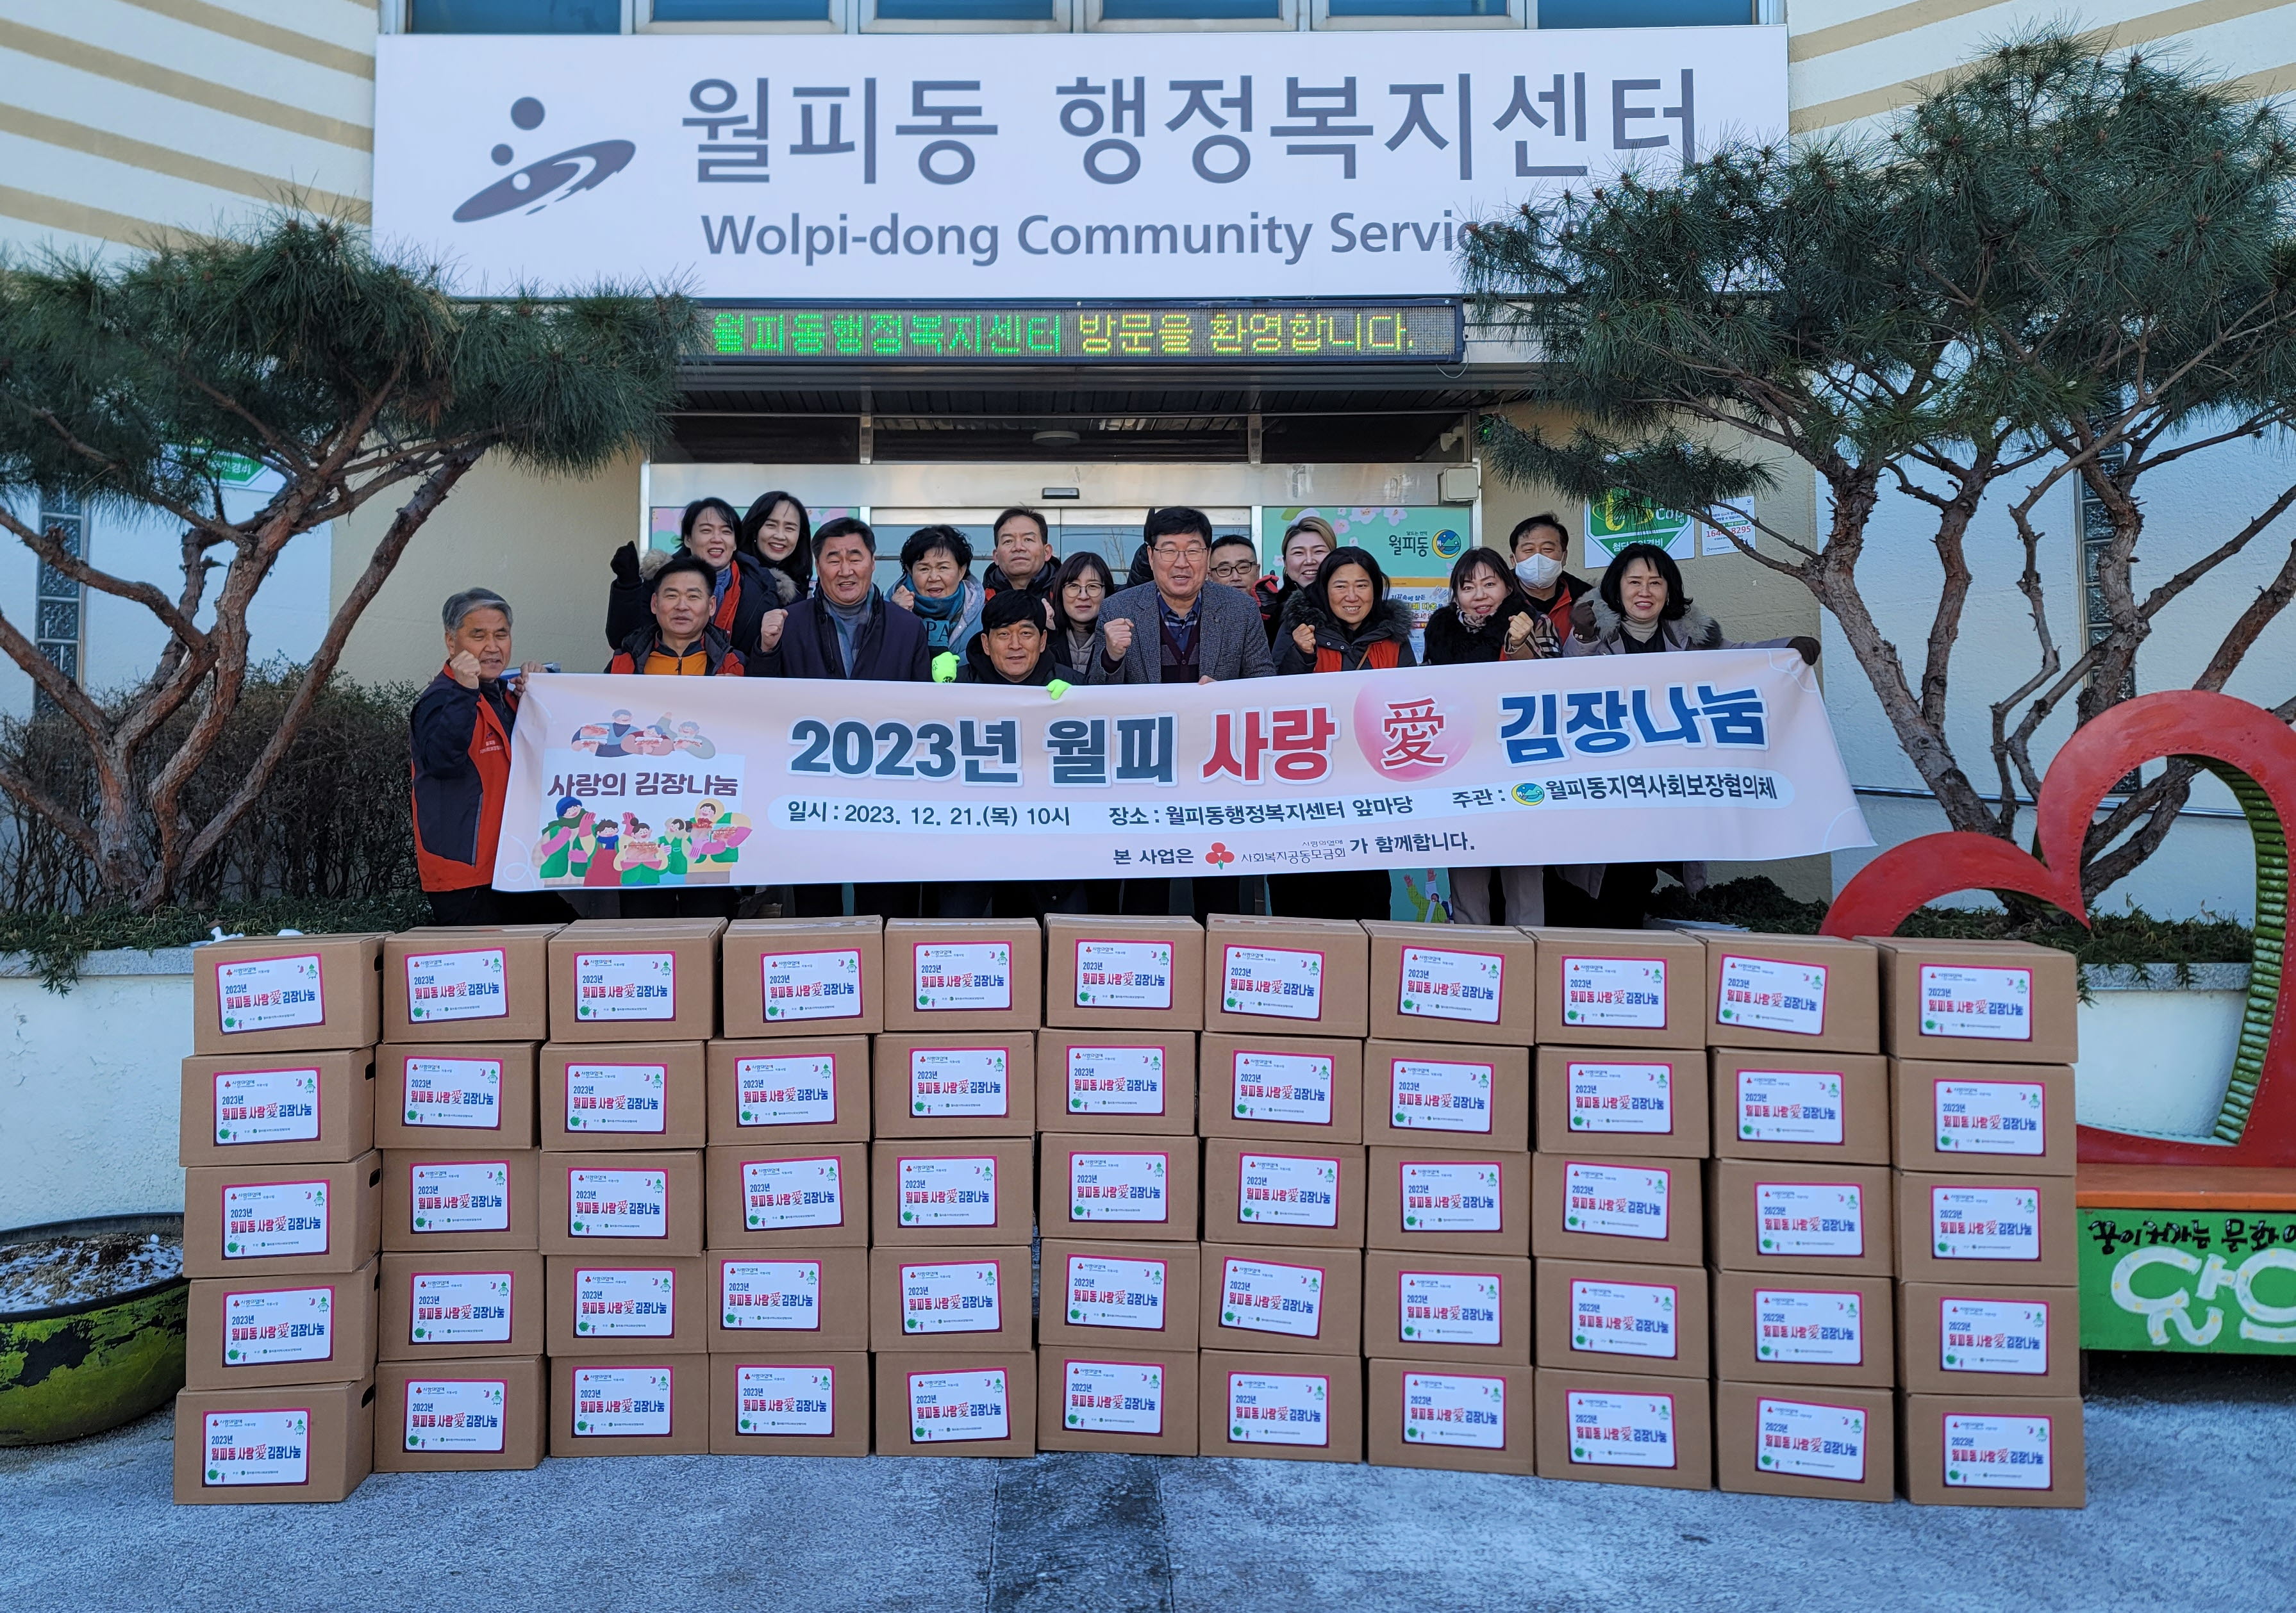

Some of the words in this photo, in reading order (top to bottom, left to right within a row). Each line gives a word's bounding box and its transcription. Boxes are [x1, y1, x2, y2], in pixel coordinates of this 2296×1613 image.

[682, 77, 999, 185] 월피동
[1056, 69, 1694, 185] 행정복지센터
[701, 212, 999, 267] Wolpi-dong
[1017, 211, 1313, 266] Community
[1329, 209, 1506, 255] Servic
[711, 313, 1061, 353] 월피동행정복지센터
[1079, 313, 1193, 353] 방문을
[1210, 312, 1415, 352] 환영합니다.
[1388, 535, 1429, 558] 월피동
[790, 719, 1019, 783] 2023년
[1047, 716, 1174, 784] 월피
[1202, 707, 1336, 781] 사랑
[1383, 697, 1447, 768] 愛
[1501, 684, 1767, 765] 김장나눔
[547, 772, 626, 798] 사랑의
[634, 772, 738, 797] 김장나눔
[1545, 773, 1777, 801] 월피동지역사회보장협의체
[1026, 806, 1070, 827] 10시
[1165, 800, 1345, 826] 월피동행정복지센터
[1351, 795, 1413, 818] 앞마당
[1113, 849, 1133, 866] 본
[1138, 847, 1194, 865] 사업은
[1241, 847, 1345, 864] 사회복지공동모금회
[1349, 837, 1368, 854] 가
[1375, 831, 1476, 852] 함께합니다.
[1231, 966, 1252, 977] 2023년
[582, 974, 603, 983] 2023년
[1570, 979, 1592, 988] 2023년
[225, 983, 247, 994] 2023년
[582, 986, 606, 998] 월피동
[636, 985, 668, 997] 김장나눔
[1229, 977, 1254, 992] 월피동
[1283, 982, 1315, 997] 김장나눔
[1927, 987, 1951, 997] 2023년
[226, 995, 251, 1009] 월피동
[282, 988, 315, 1004] 김장나눔
[1074, 1067, 1094, 1077] 2023년
[410, 1079, 431, 1088] 2023년
[743, 1079, 764, 1089] 2023년
[1074, 1079, 1097, 1091] 월피동
[1126, 1079, 1157, 1092] 김장나눔
[410, 1090, 434, 1103] 월피동
[463, 1092, 494, 1105] 김장나눔
[744, 1090, 767, 1104] 월피동
[797, 1088, 828, 1101] 김장나눔
[904, 1180, 926, 1189] 2023년
[1246, 1176, 1267, 1186] 2023년
[576, 1189, 596, 1199] 2023년
[1246, 1187, 1270, 1201] 월피동
[1299, 1190, 1331, 1204] 김장나눔
[1571, 1184, 1593, 1195] 2023년
[905, 1191, 929, 1204] 월피동
[958, 1190, 989, 1203] 김장나눔
[230, 1207, 252, 1218] 2023년
[576, 1201, 599, 1214] 월피동
[629, 1202, 660, 1215] 김장나눔
[1940, 1209, 1962, 1219] 2023년
[230, 1220, 255, 1234] 월피동
[287, 1216, 321, 1231] 김장나눔
[728, 1282, 749, 1291] 2023년
[1074, 1277, 1095, 1287] 2023년
[418, 1295, 440, 1305] 2023년
[728, 1293, 752, 1306] 월피동
[781, 1294, 813, 1307] 김장나눔
[1073, 1289, 1097, 1303] 월피동
[1126, 1292, 1158, 1307] 김장나눔
[1406, 1294, 1427, 1304] 2023년
[418, 1307, 442, 1320] 월피동
[472, 1306, 504, 1319] 김장나눔
[1762, 1312, 1784, 1323] 2023년
[580, 1389, 601, 1398] 2023년
[916, 1394, 936, 1404] 2023년
[580, 1400, 604, 1413] 월피동
[633, 1400, 665, 1412] 김장나눔
[917, 1406, 940, 1419] 월피동
[970, 1403, 1001, 1416] 김장나눔
[211, 1435, 233, 1445] 2023년
[1951, 1436, 1974, 1446] 2023년
[211, 1447, 236, 1461] 월피동
[267, 1445, 301, 1459] 김장나눔
